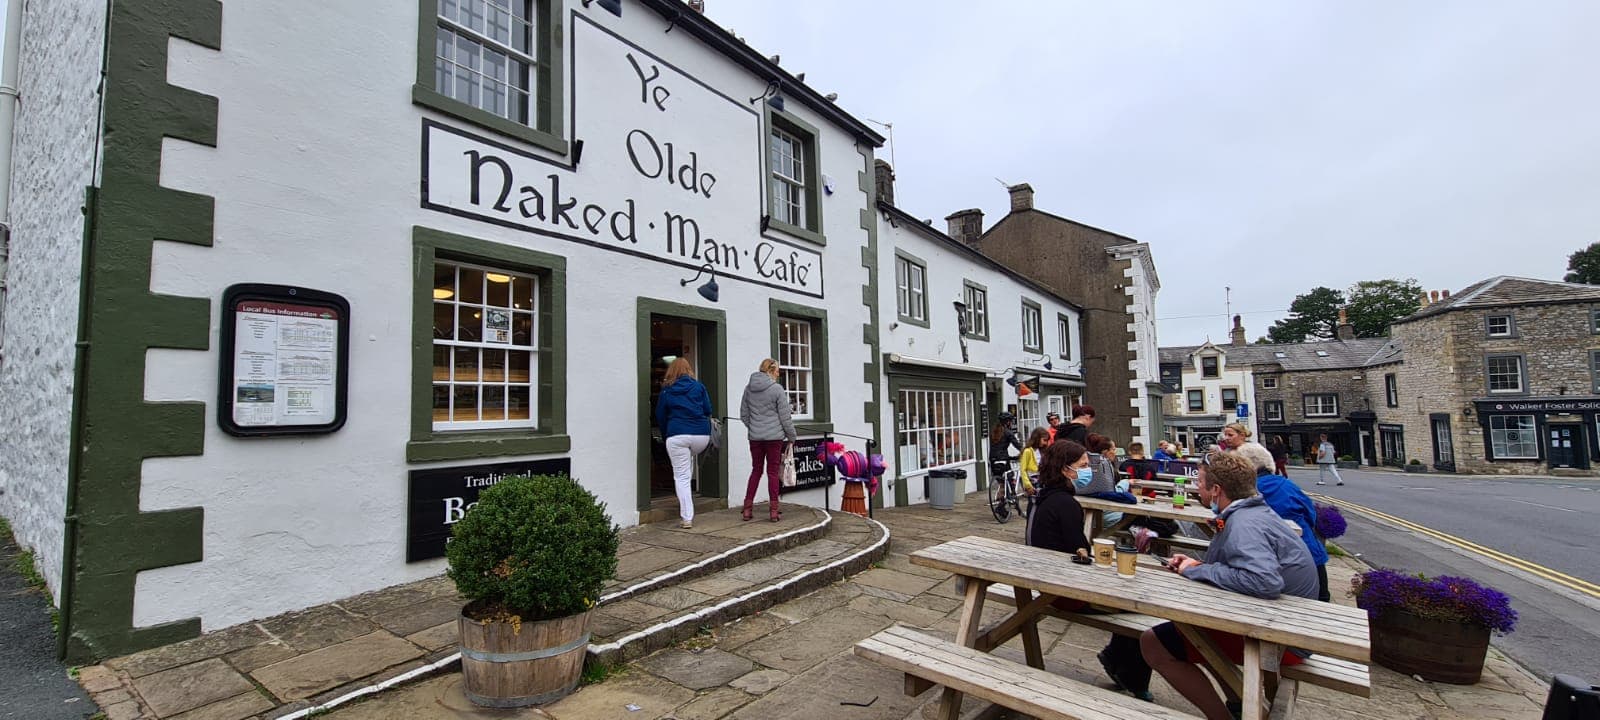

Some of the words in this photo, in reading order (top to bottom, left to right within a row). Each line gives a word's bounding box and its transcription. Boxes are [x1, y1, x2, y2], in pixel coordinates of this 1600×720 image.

[626, 53, 671, 111] Ye
[626, 129, 716, 198] Olde
[464, 150, 637, 243] Naked
[664, 211, 740, 270] Man
[242, 305, 261, 313] Local
[277, 309, 317, 317] Information
